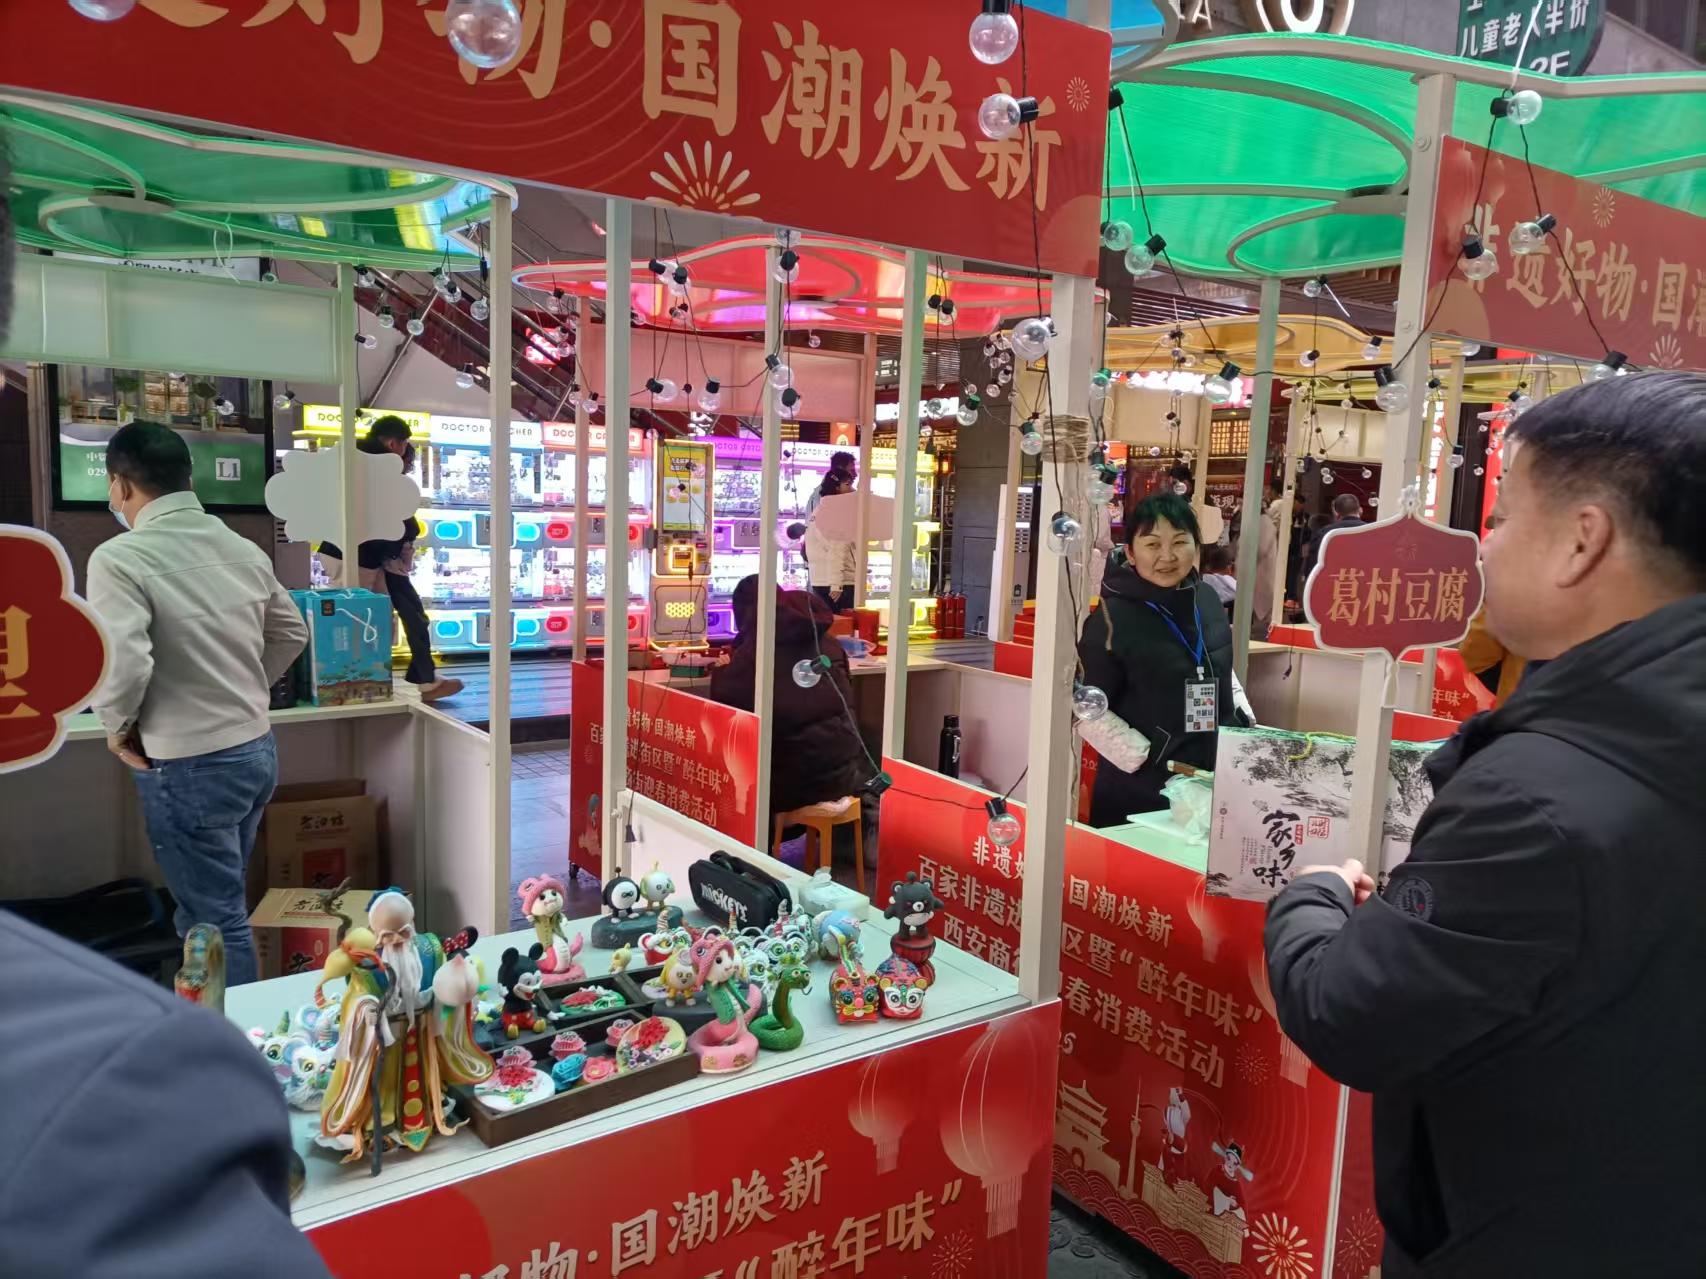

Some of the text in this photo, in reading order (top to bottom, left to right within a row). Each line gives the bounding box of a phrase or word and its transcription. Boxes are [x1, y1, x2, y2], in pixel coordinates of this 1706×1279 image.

[441, 422, 485, 433] DOCTOR
[1327, 566, 1469, 626] 葛村豆腐
[1252, 810, 1301, 888] 家乡味
[459, 1151, 829, 1279] 物·国潮焕新
